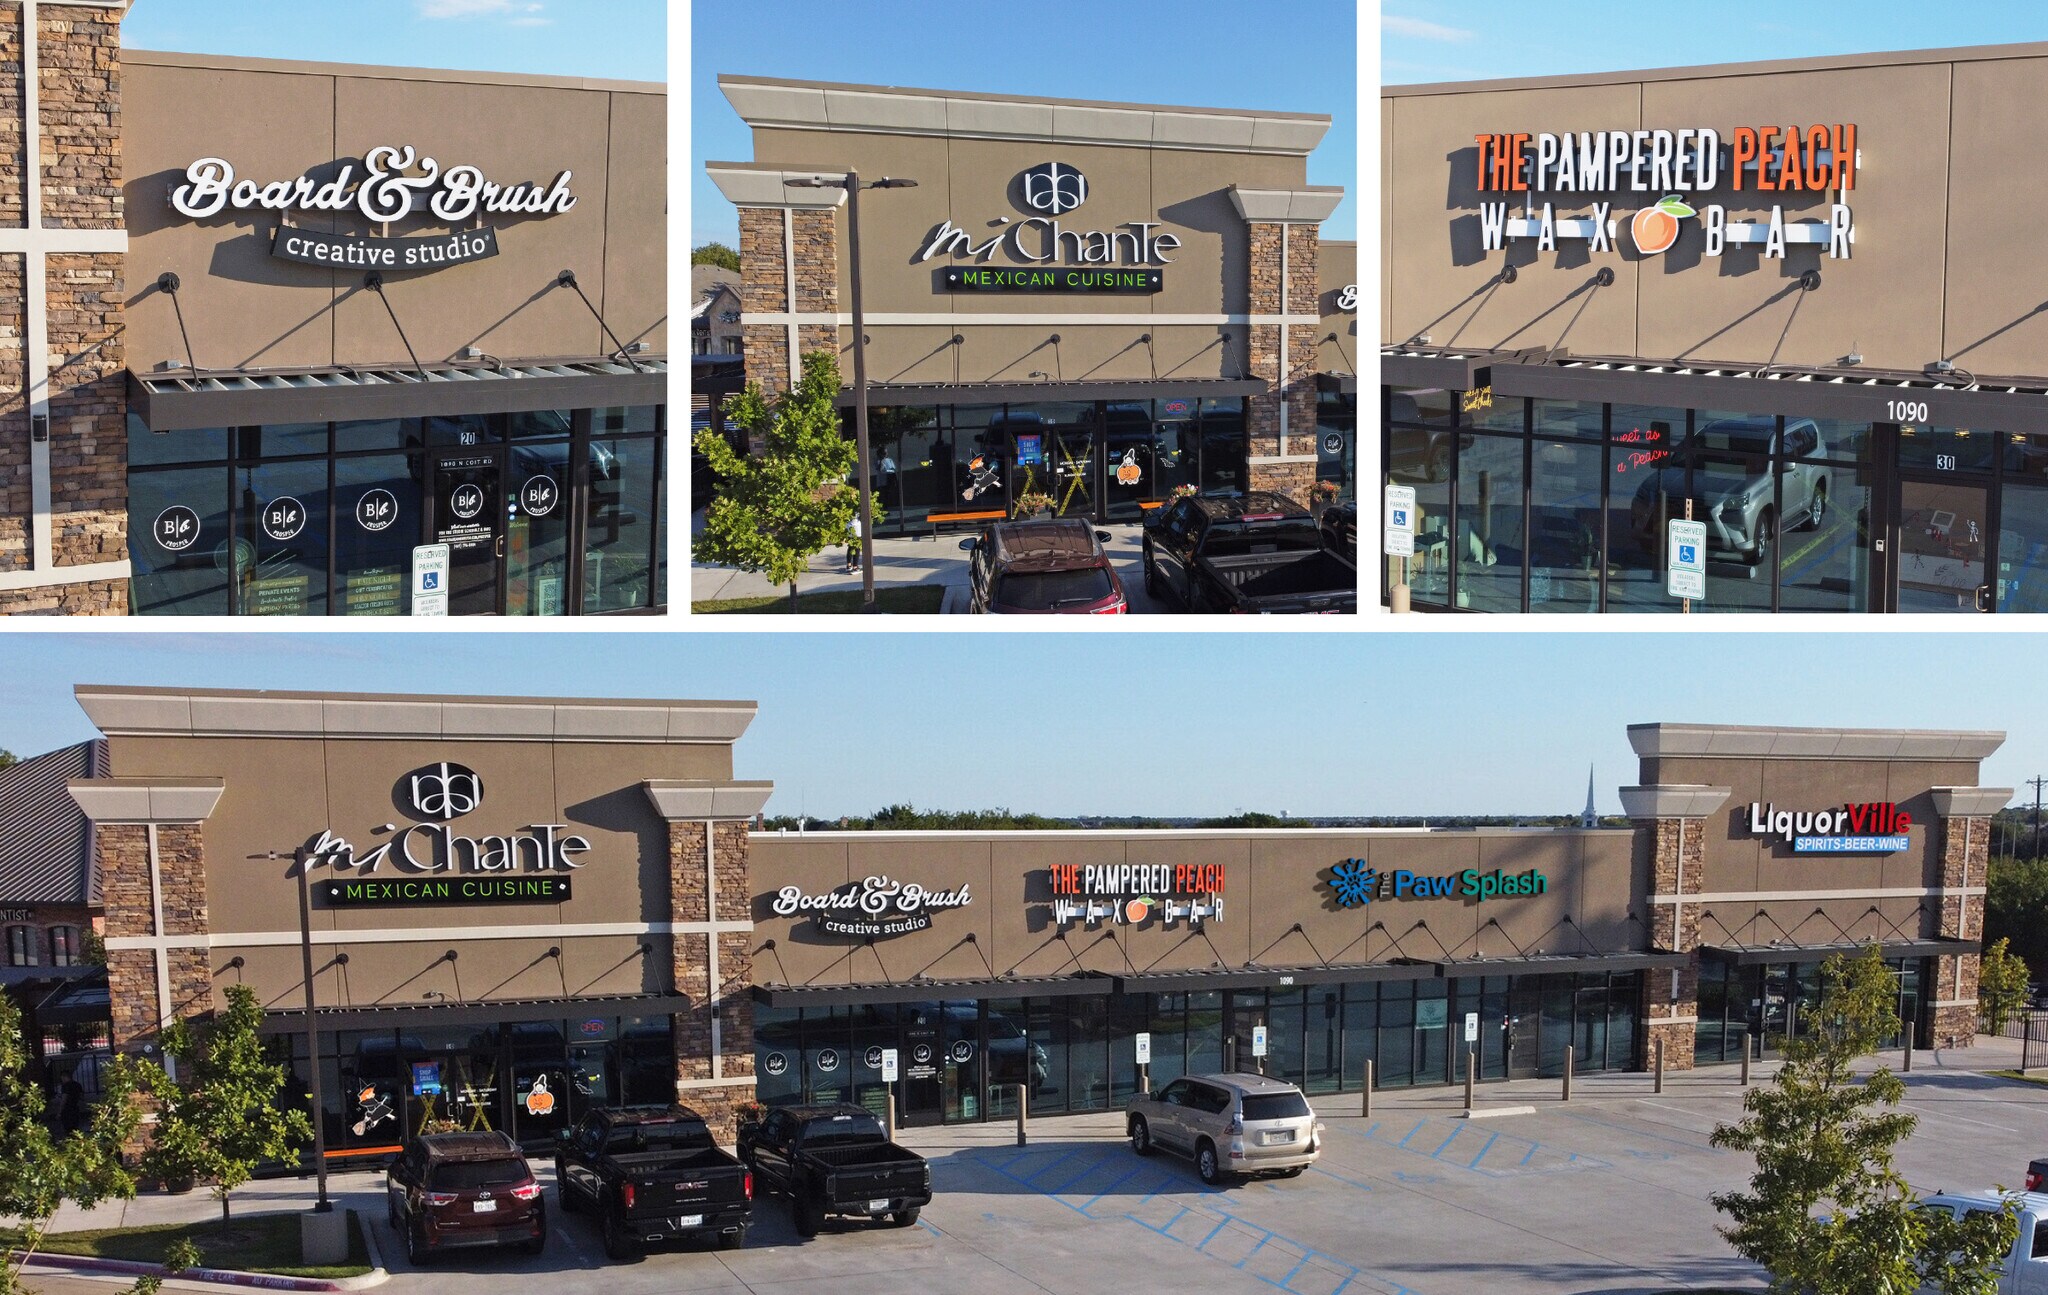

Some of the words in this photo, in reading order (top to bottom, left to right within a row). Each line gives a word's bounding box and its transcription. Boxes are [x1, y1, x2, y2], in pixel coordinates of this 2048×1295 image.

[1475, 133, 1532, 191] THE
[1537, 128, 1718, 191] PAMPERED
[1733, 124, 1857, 191] PEACH
[172, 157, 354, 218] Board
[357, 146, 439, 222] &
[431, 165, 577, 222] Brush
[286, 235, 396, 265] creative
[963, 271, 1055, 286] MEXICAN
[1067, 272, 1146, 287] CUISINE
[1165, 403, 1187, 411] OPEN
[1887, 400, 1928, 422] 1090
[461, 431, 475, 445] 20
[1645, 430, 1660, 440] as
[1938, 456, 1954, 470] 30
[1672, 525, 1703, 536] RESERVED
[1675, 536, 1700, 545] PARKING
[416, 550, 446, 560] RESERVED
[419, 561, 443, 571] PARKING
[1797, 838, 1908, 850] SPIRITS-BEER-WINE
[1049, 864, 1081, 894] THE
[1084, 864, 1171, 894] PAMPERED
[1175, 864, 1225, 893] PEACH
[1380, 872, 1391, 897] The
[1395, 869, 1456, 897] Paw
[1462, 869, 1547, 901] Splash
[346, 882, 450, 899] MEXICAN
[461, 881, 553, 897] CUISINE
[771, 886, 860, 915] Board
[859, 876, 899, 914] &
[895, 883, 972, 914] Brush
[825, 918, 880, 935] creative
[1280, 976, 1294, 985] 1090
[675, 1181, 708, 1190] GMC
[218, 1273, 236, 1283] LANE
[265, 1278, 295, 1289] PARKING
